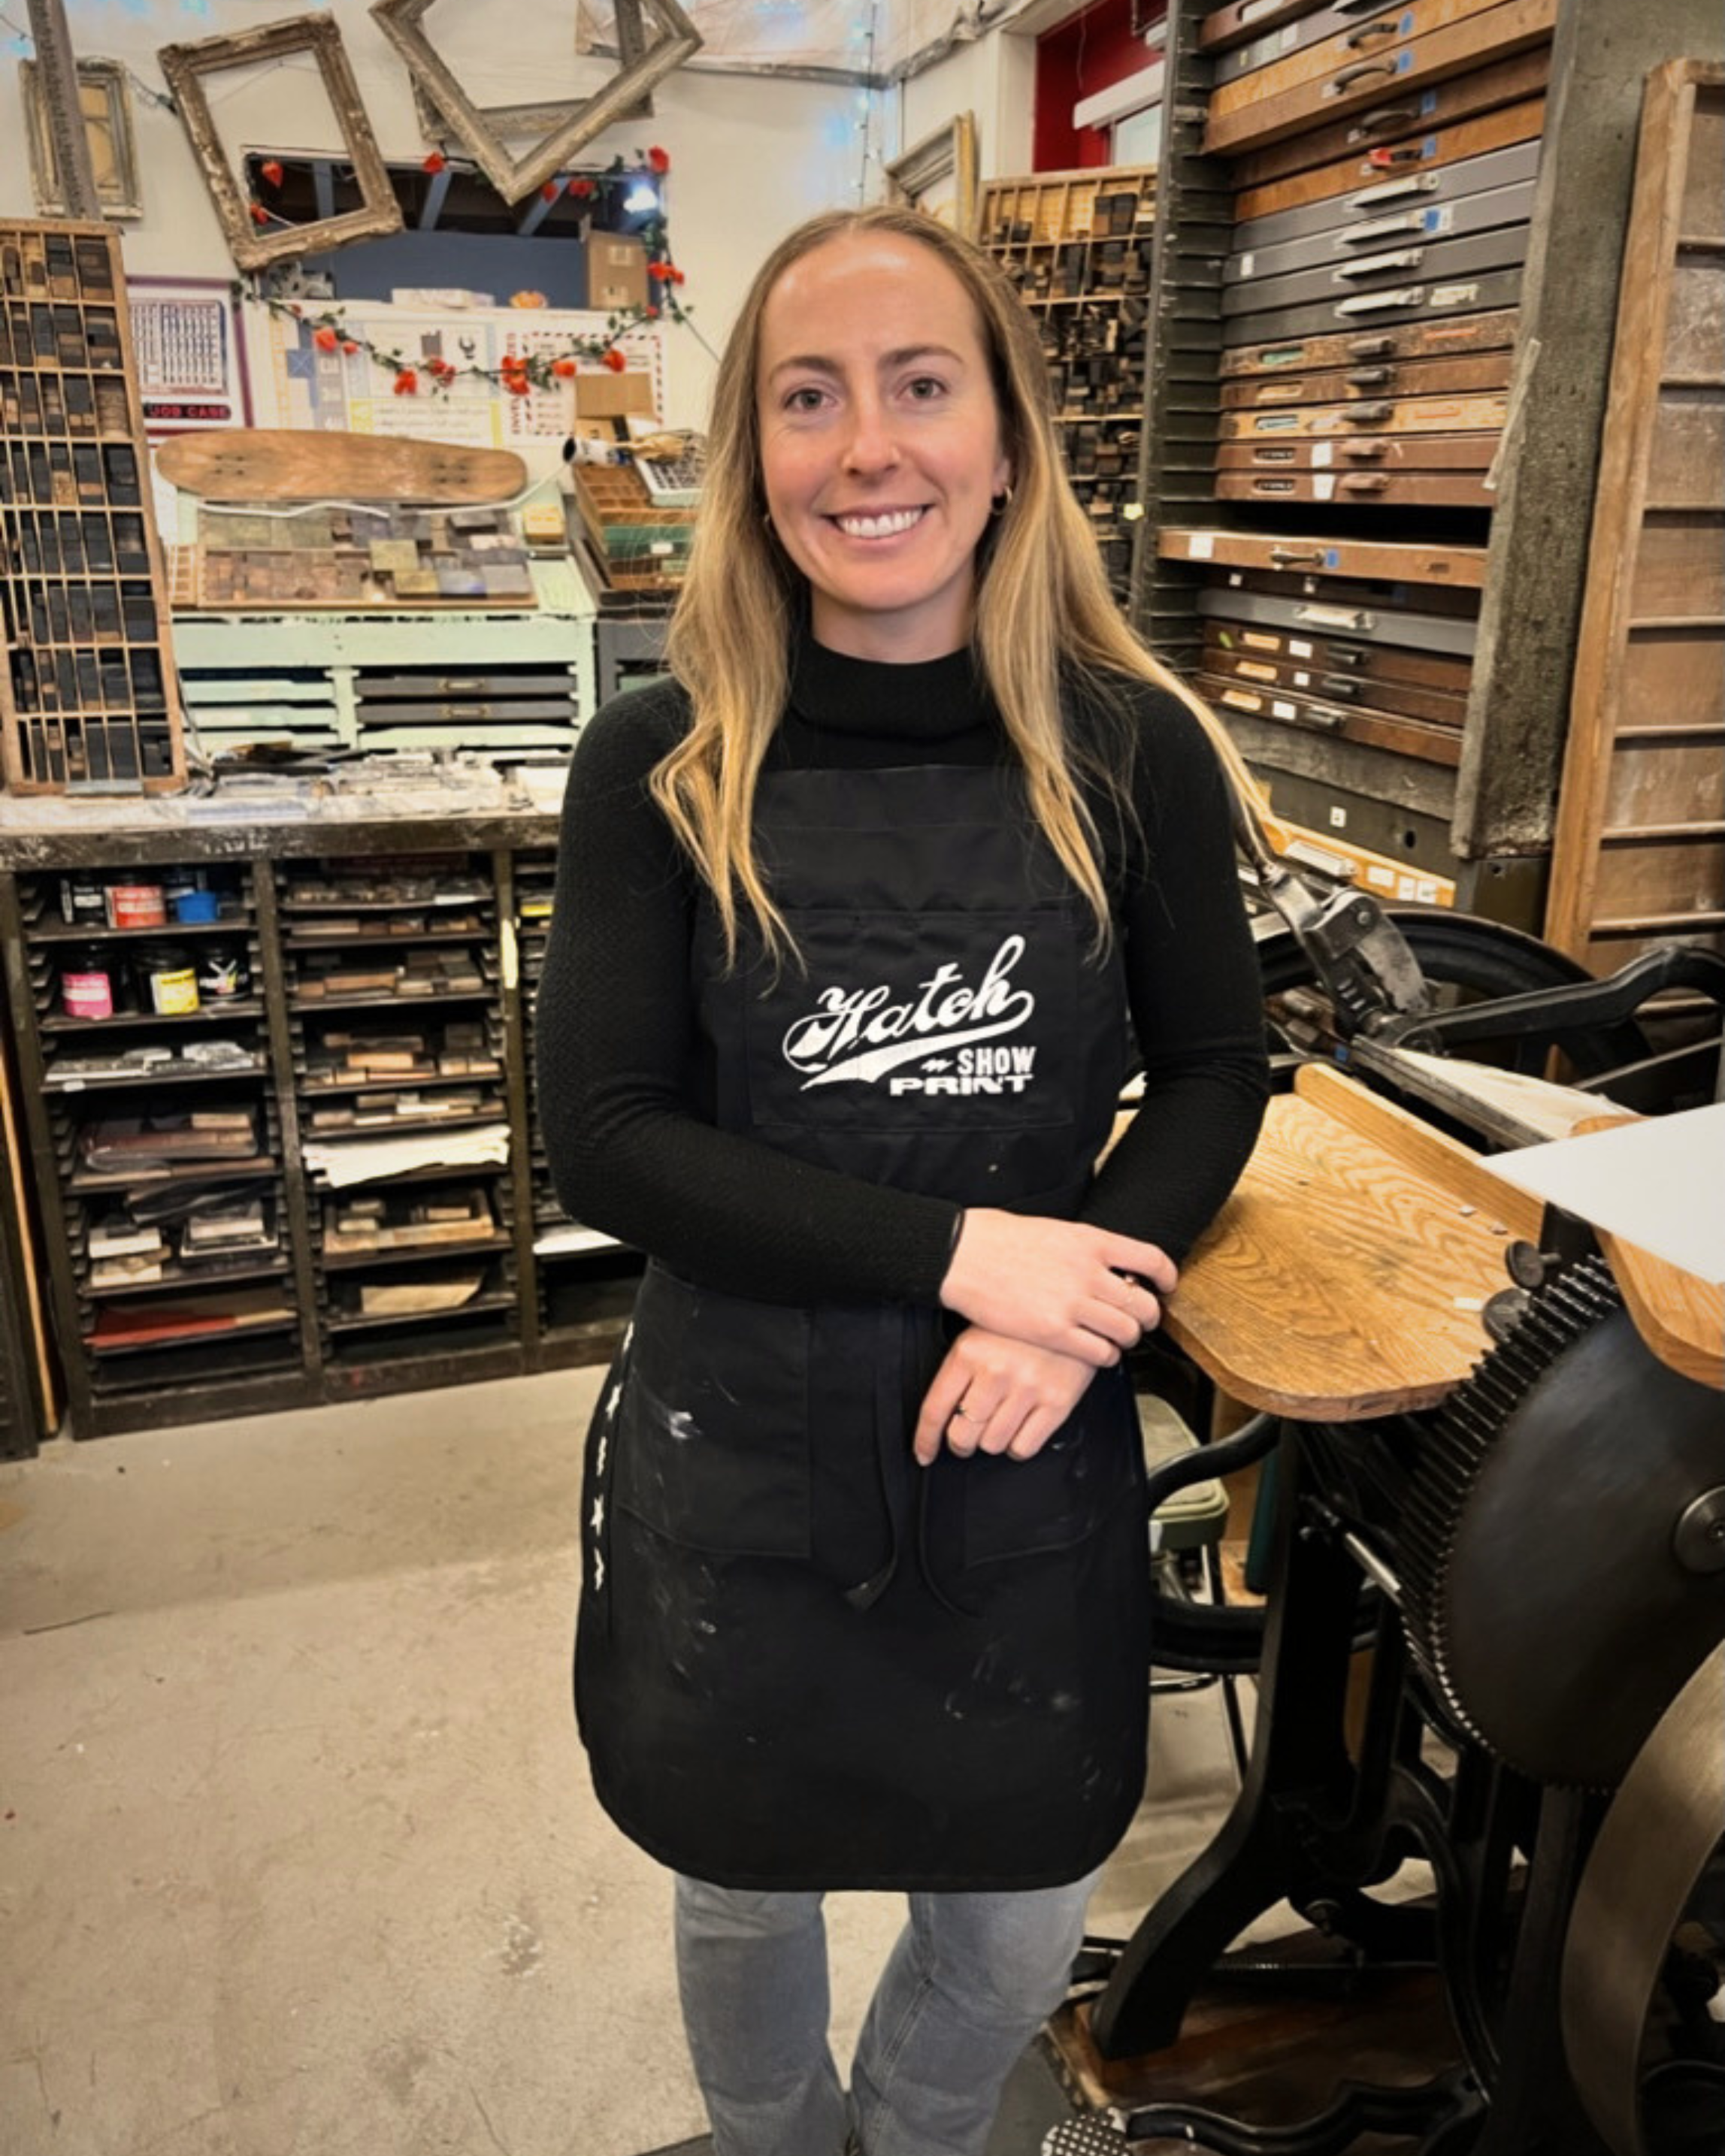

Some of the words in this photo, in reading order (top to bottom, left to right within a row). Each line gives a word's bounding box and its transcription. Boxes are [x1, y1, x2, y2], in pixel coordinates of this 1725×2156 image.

[782, 934, 1035, 1073] Hatch
[958, 1046, 1037, 1075] SHOW
[889, 1075, 1034, 1096] PRINT
